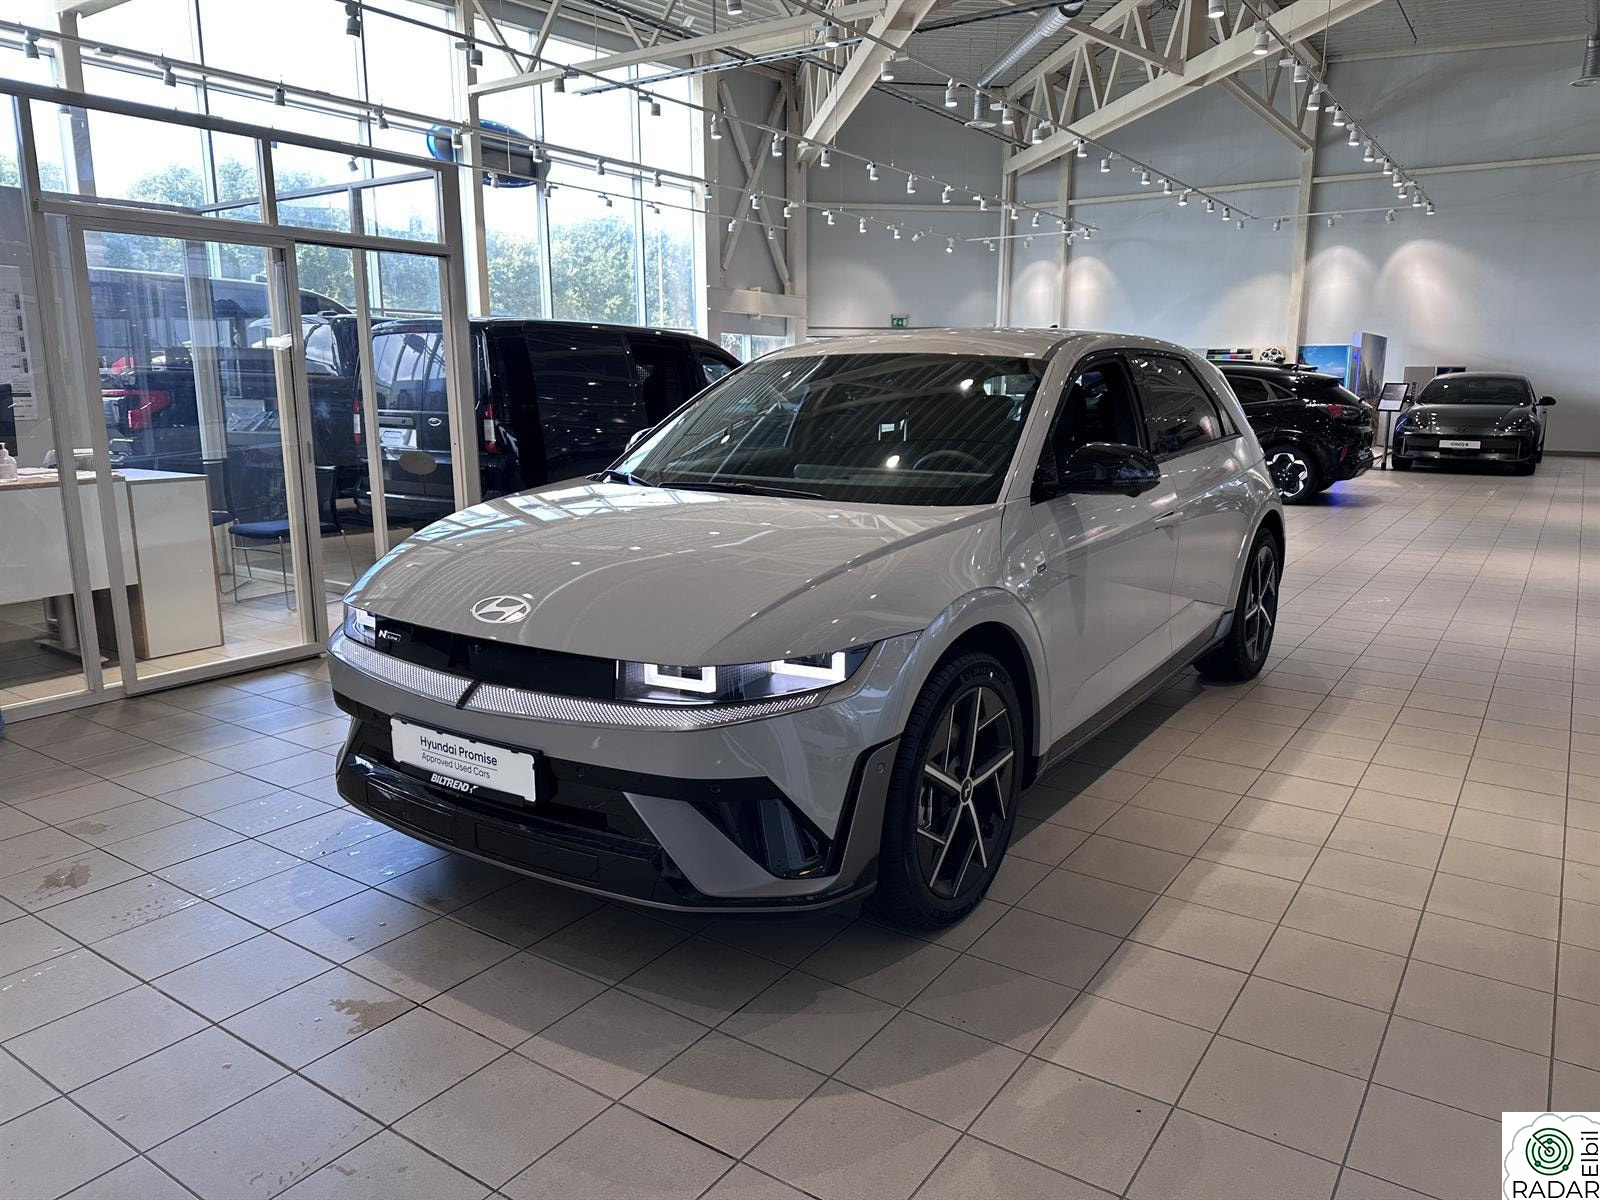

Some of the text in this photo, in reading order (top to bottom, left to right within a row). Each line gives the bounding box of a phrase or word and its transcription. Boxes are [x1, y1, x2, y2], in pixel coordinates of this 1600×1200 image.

[420, 735, 498, 766] Hyundai Promise
[421, 752, 491, 779] Approved Used Cars
[430, 773, 469, 792] BILTREND
